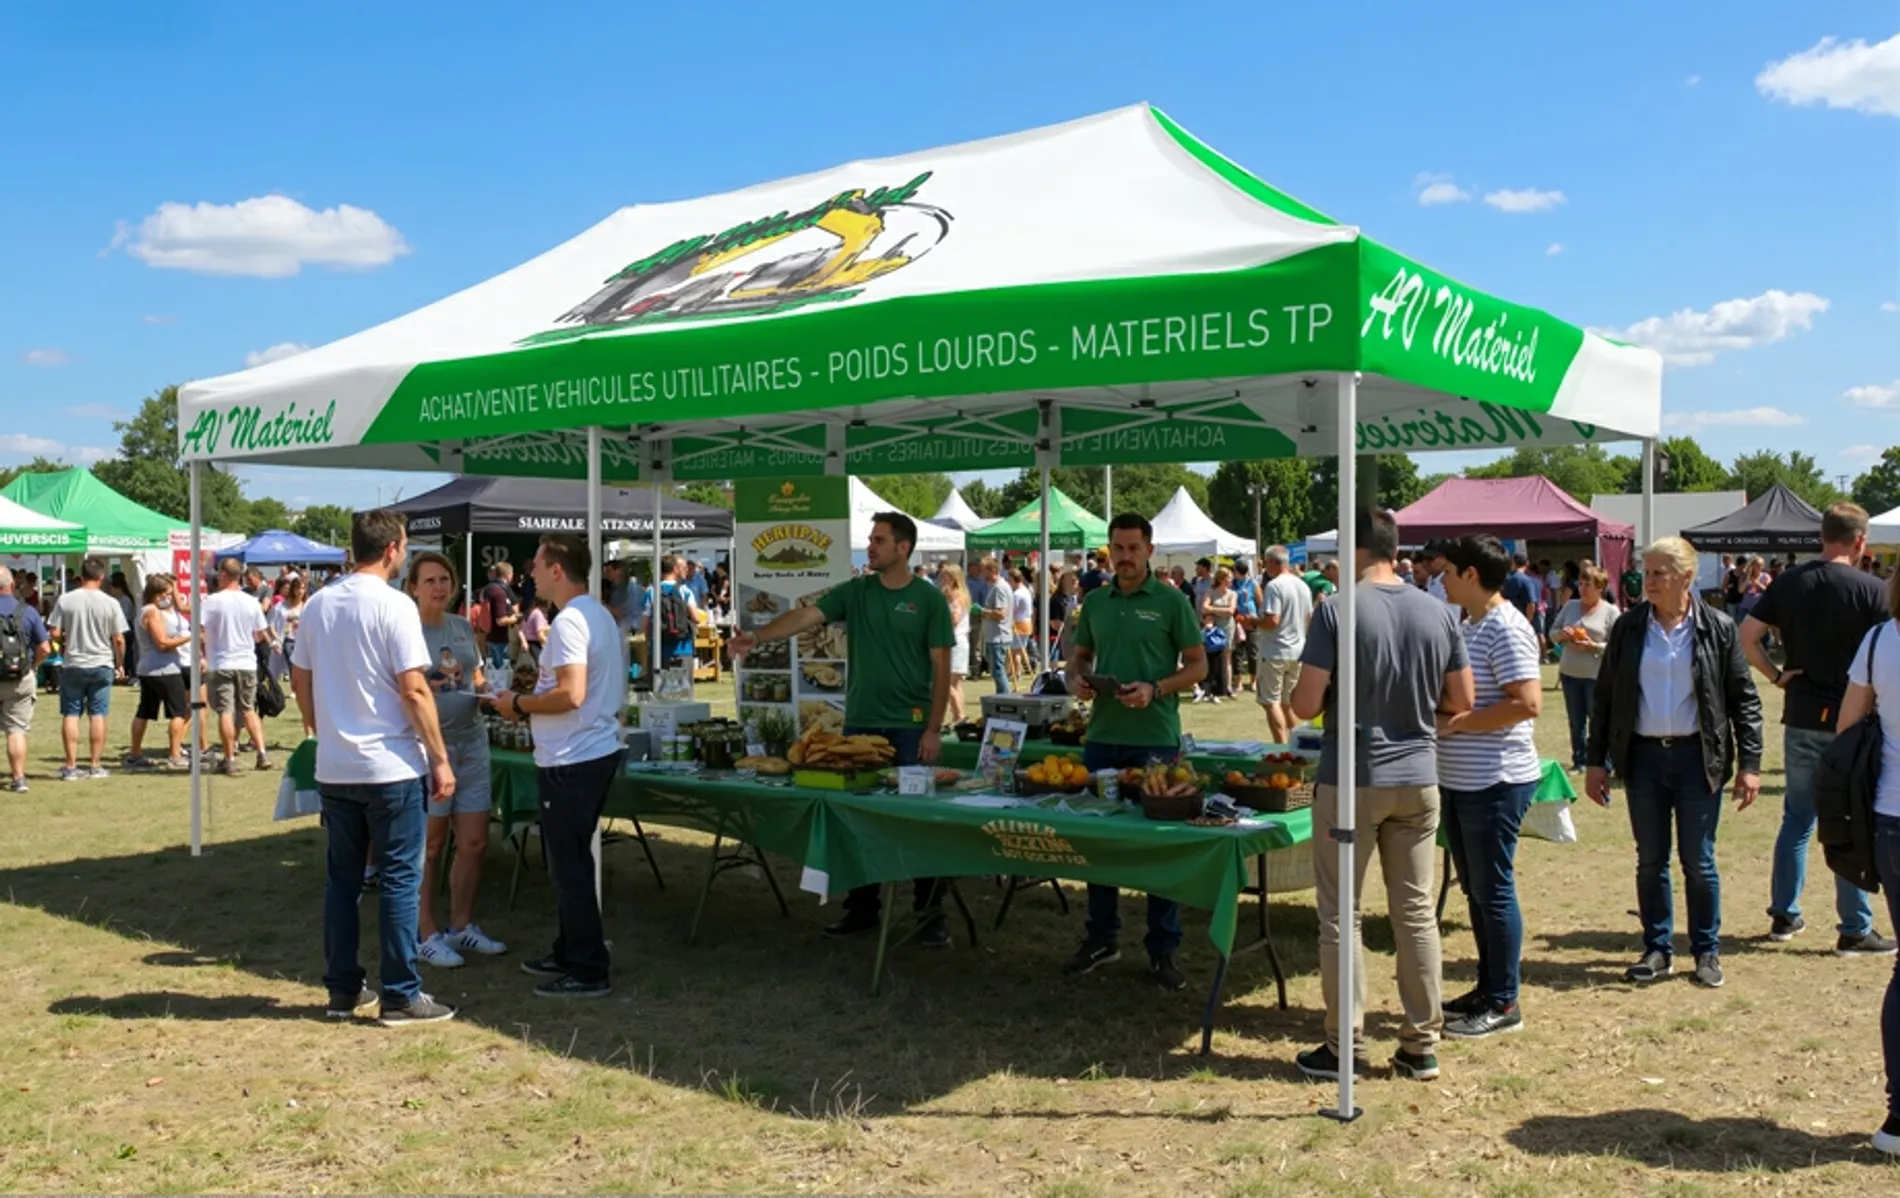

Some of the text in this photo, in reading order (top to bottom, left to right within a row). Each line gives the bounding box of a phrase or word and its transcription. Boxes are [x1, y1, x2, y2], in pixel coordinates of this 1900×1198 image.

[419, 384, 539, 422] ACHAT/VENTE
[543, 371, 657, 409] VEHICULES
[662, 357, 803, 400] UTILITAIRES
[828, 342, 909, 384] POIDS
[917, 329, 1038, 374] LOURDS
[1071, 307, 1271, 360] MATERIELS
[1282, 303, 1334, 345] TP
[1361, 267, 1537, 383] AV Matériel
[182, 399, 336, 455] AV Matériel
